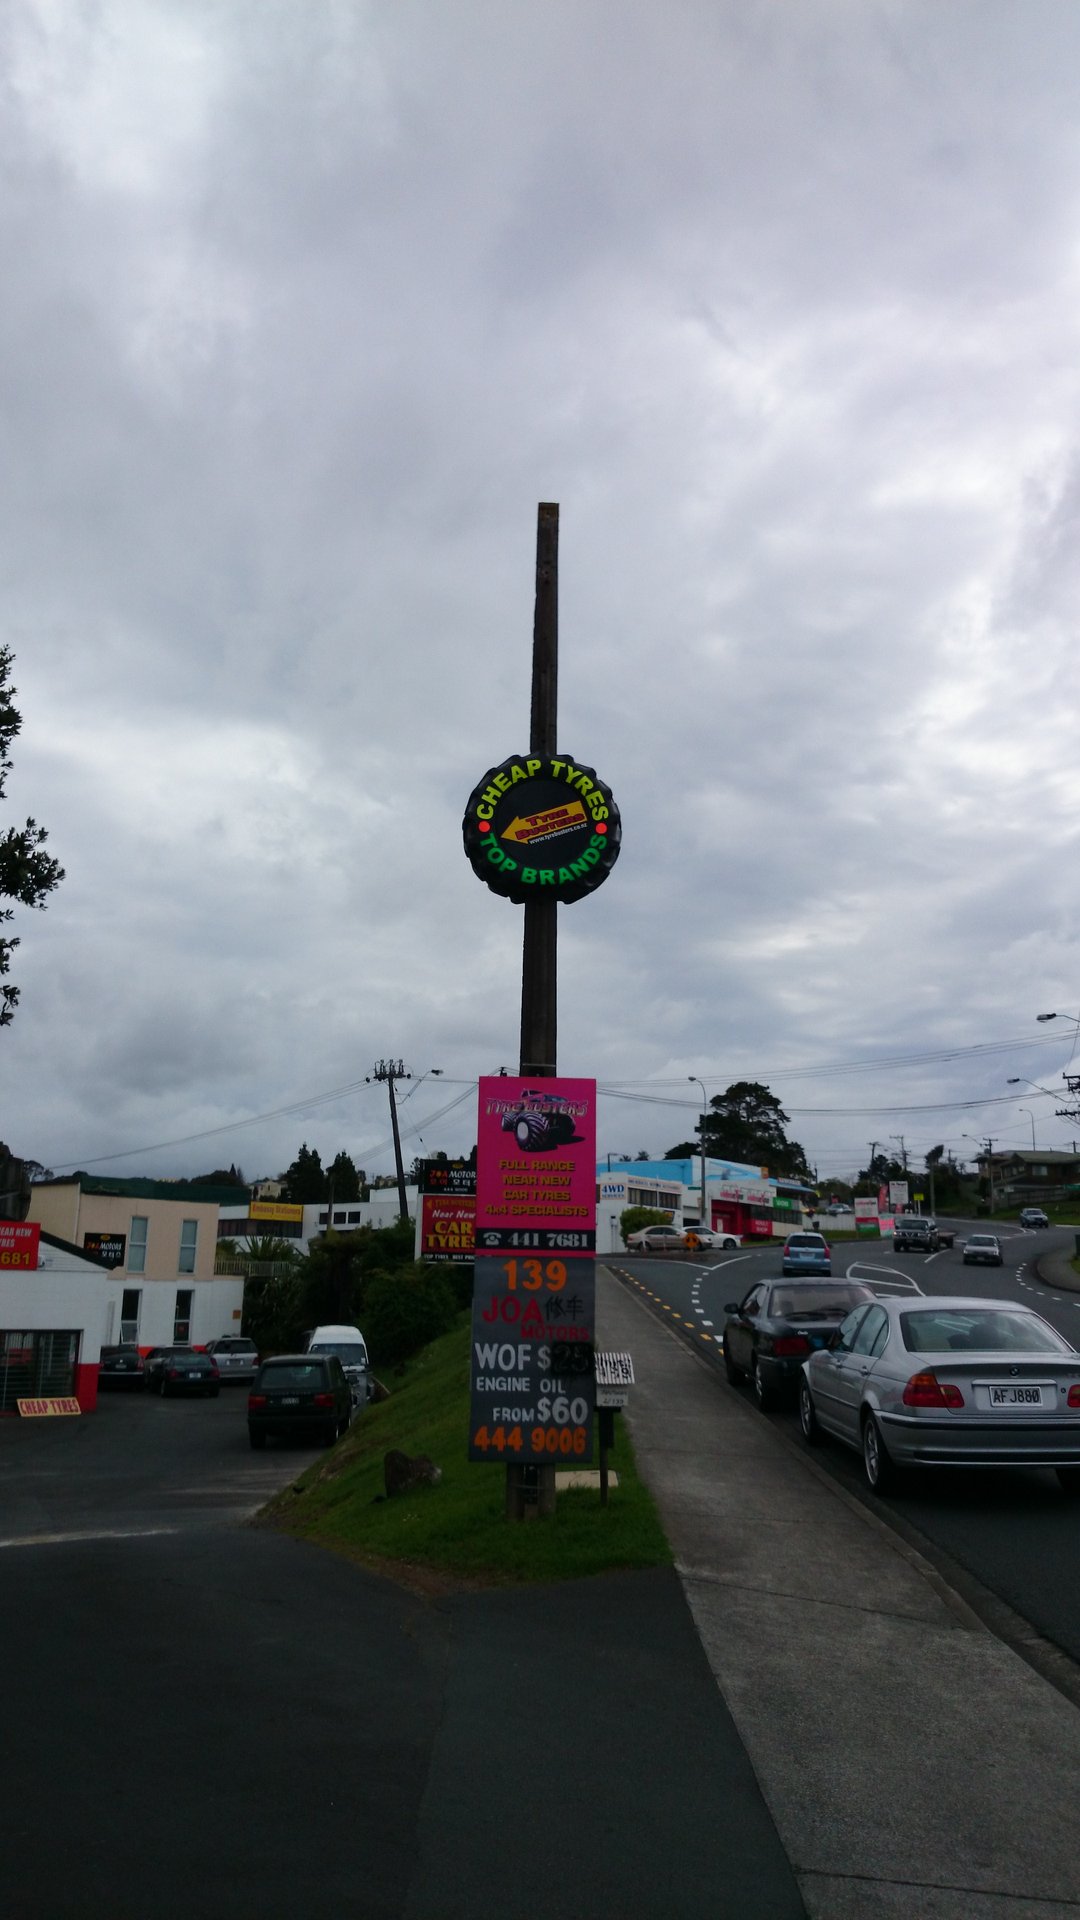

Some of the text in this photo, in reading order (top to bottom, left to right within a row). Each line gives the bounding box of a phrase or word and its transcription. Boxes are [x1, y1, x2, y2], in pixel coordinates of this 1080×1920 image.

[476, 759, 609, 821] CHEAP TYRES
[479, 832, 608, 885] TOP BRANDS
[485, 1098, 588, 1117] TYRE BUSTERS
[448, 1170, 476, 1178] MOTOR
[499, 1160, 576, 1172] FULL RANGE
[503, 1175, 571, 1187] NEAR NEW
[602, 1184, 625, 1194] 4WD
[503, 1190, 570, 1201] CAR TYRES
[431, 1209, 476, 1219] Near New
[485, 1204, 589, 1217] 4x4 SPECIALISTS
[434, 1220, 473, 1235] CAR
[507, 1232, 588, 1248] 441 7681
[503, 1259, 568, 1291] 139
[482, 1297, 545, 1324] JOA
[520, 1324, 590, 1341] MOTORS
[475, 1343, 532, 1372] WOF
[476, 1376, 566, 1393] ENGINE OIL
[20, 1399, 79, 1415] CHEAP TYRES
[492, 1397, 588, 1425] FROM $60
[474, 1425, 587, 1454] 444 9006
